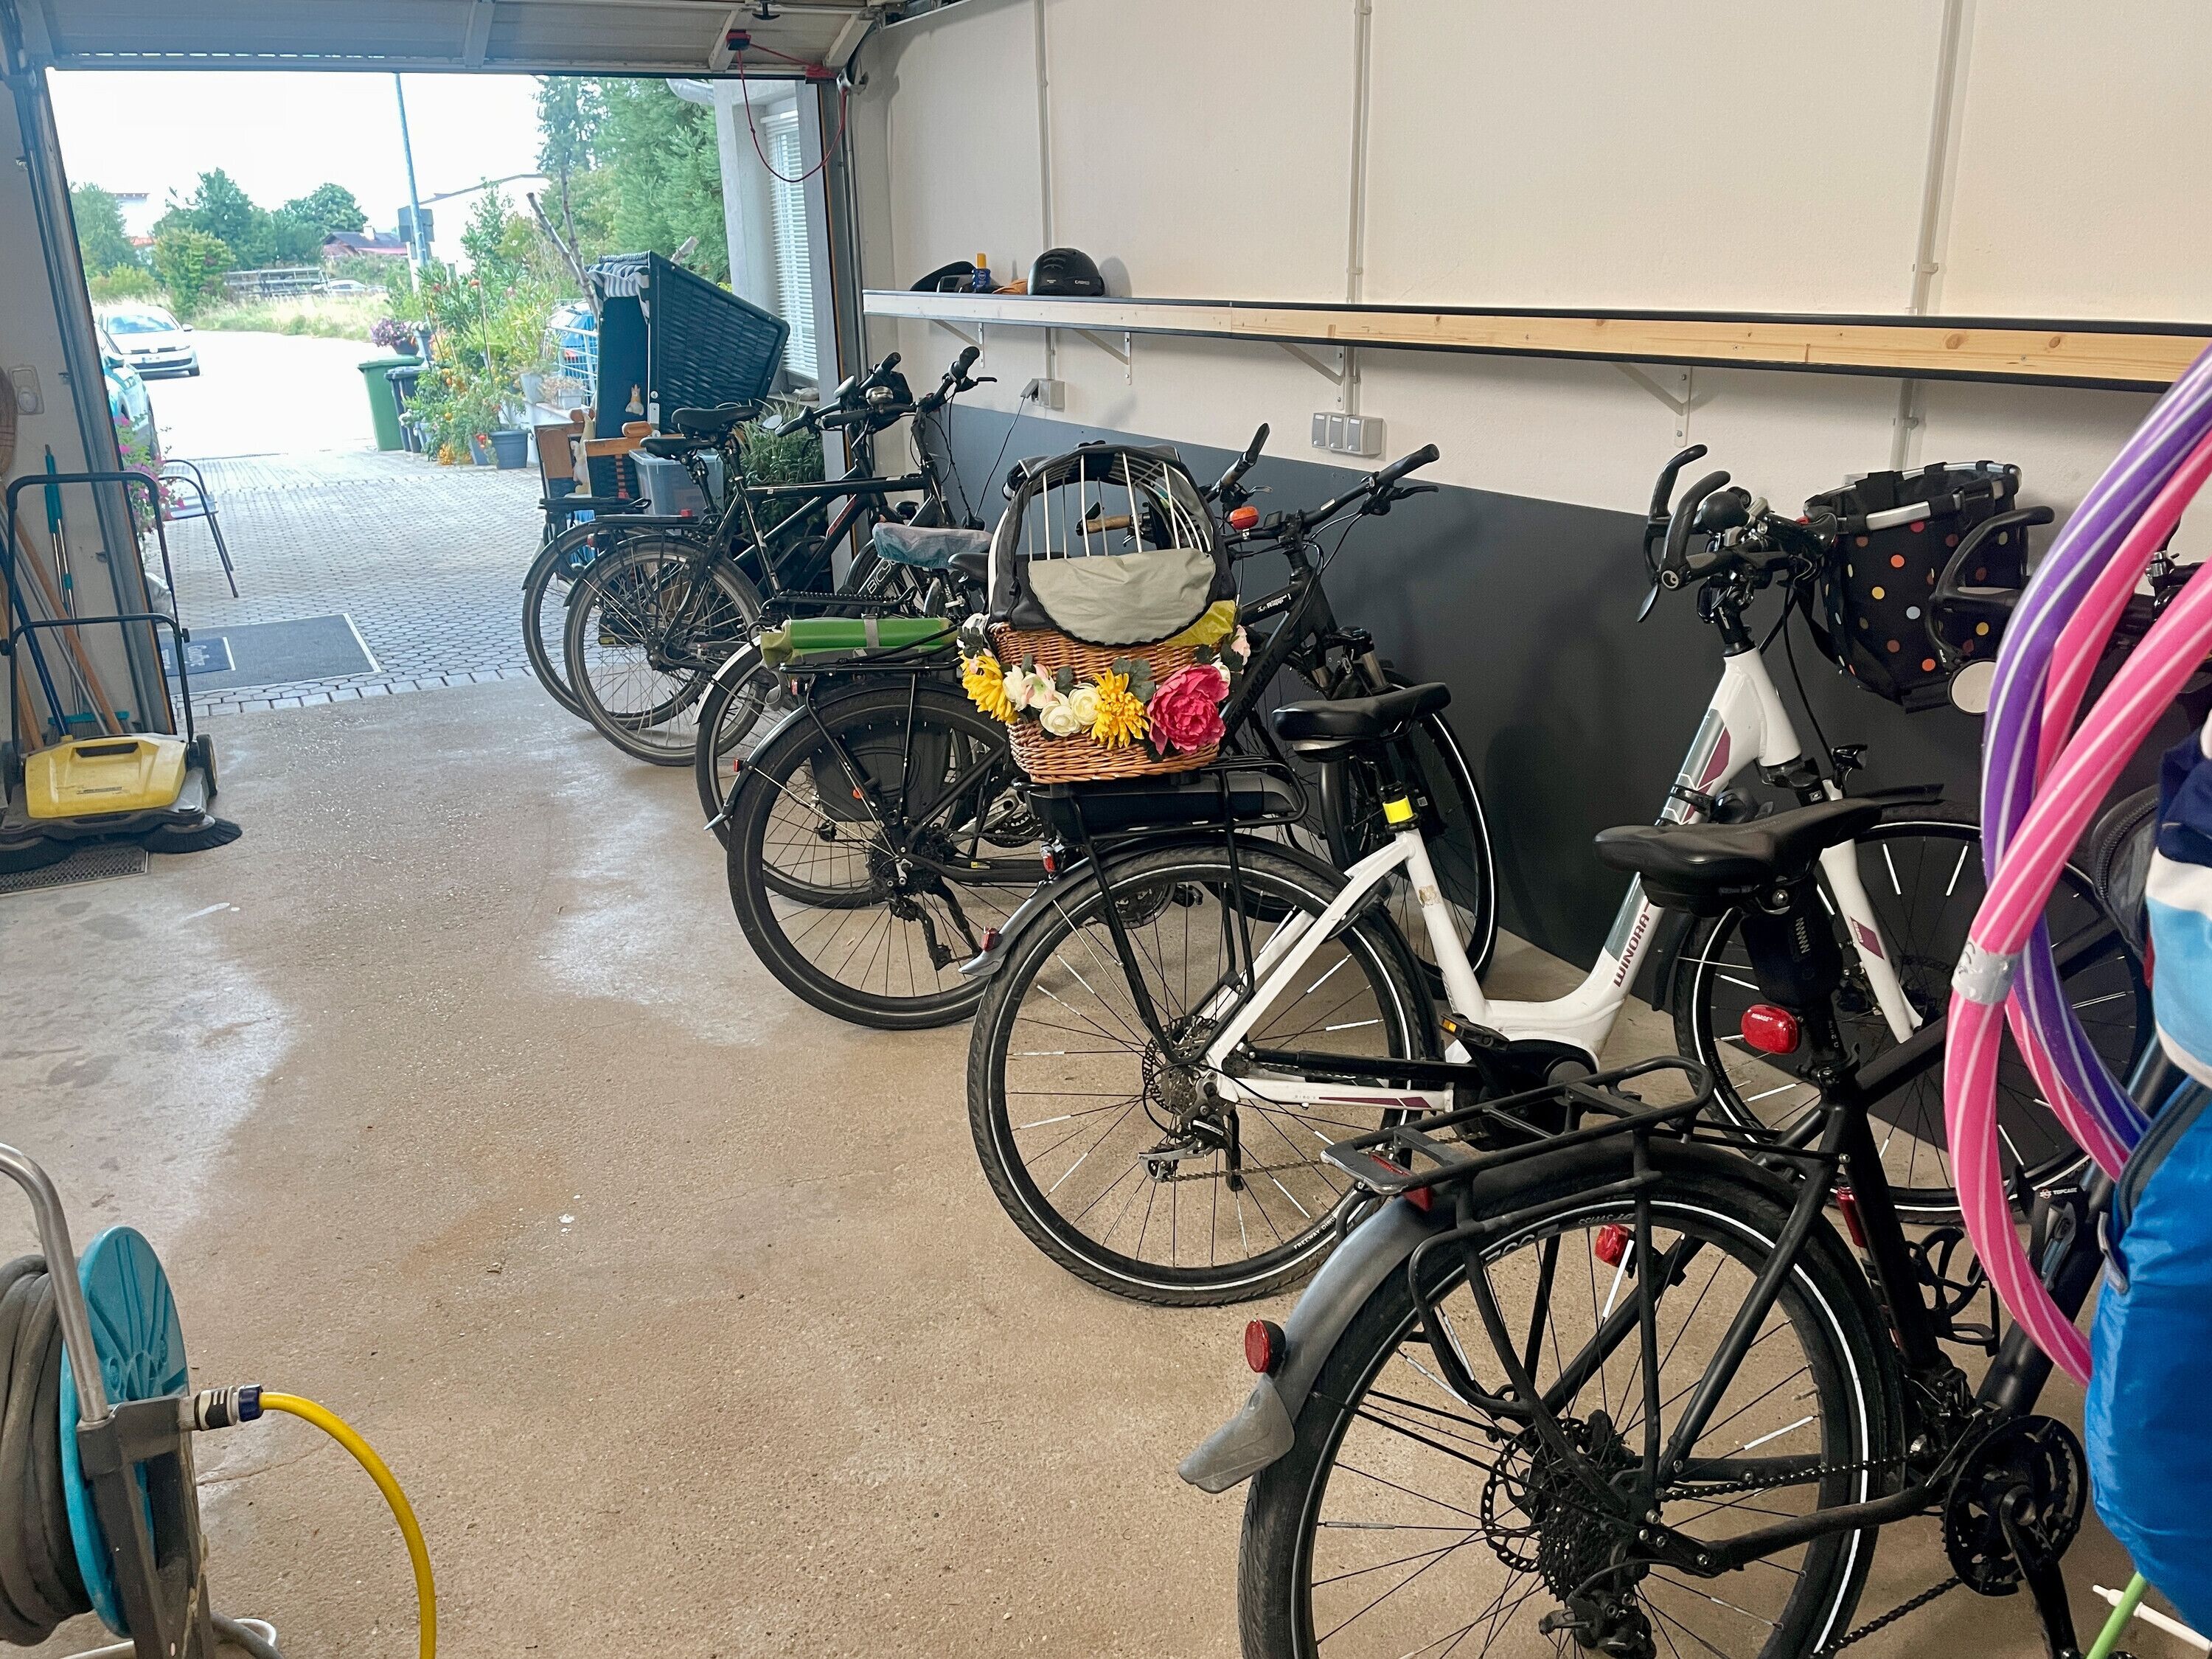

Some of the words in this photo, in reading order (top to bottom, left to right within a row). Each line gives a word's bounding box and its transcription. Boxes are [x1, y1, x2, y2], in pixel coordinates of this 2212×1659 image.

[866, 559, 897, 594] BICY
[1613, 914, 1649, 987] WINORA
[1293, 1229, 1321, 1250] FREEWAY
